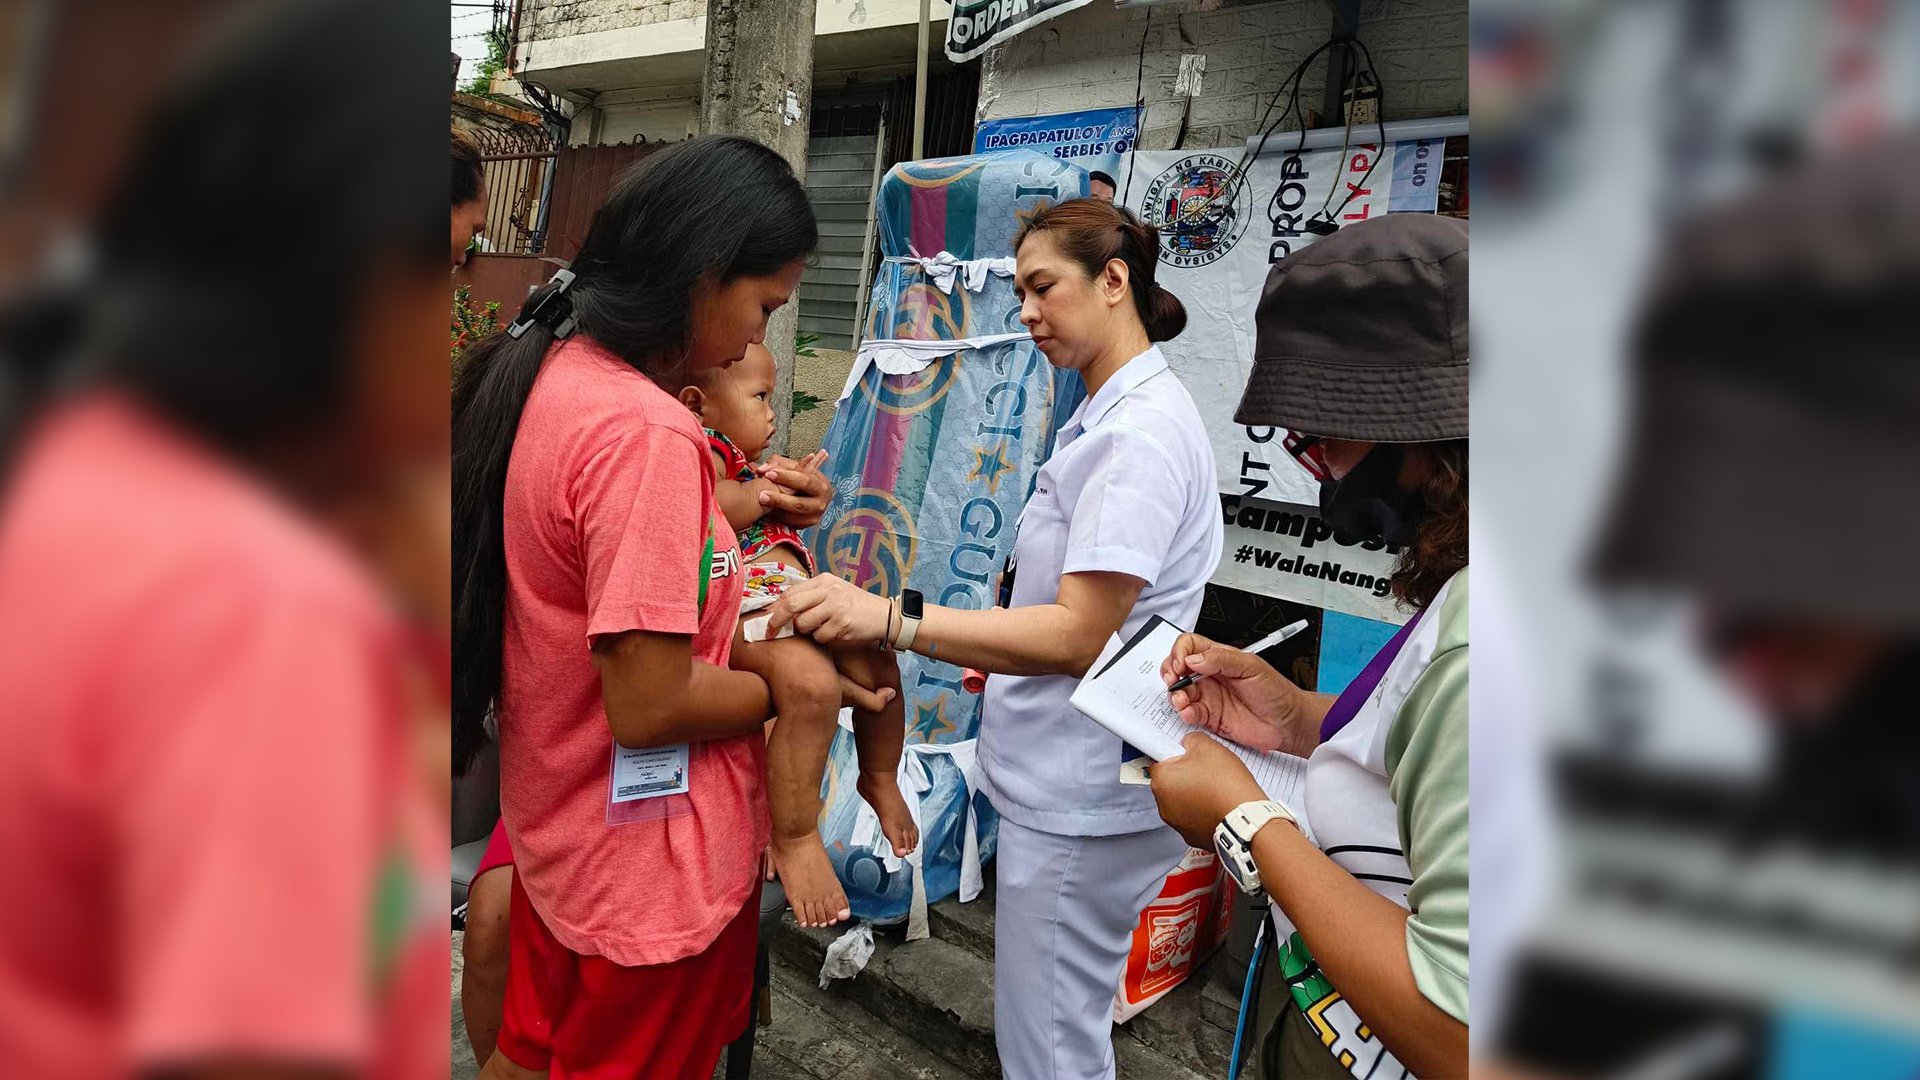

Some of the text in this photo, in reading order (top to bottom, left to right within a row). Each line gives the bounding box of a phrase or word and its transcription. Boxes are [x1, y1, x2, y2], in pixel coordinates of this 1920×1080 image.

[985, 125, 1135, 148] IPAGPAPATULOY ANG
[1053, 139, 1134, 159] SERBISYO!
[1143, 173, 1171, 224] AWIGAN
[1175, 160, 1192, 173] NG
[1268, 148, 1313, 265] PROP
[915, 496, 1003, 697] GUCI
[1233, 544, 1393, 598] #WalaNang
